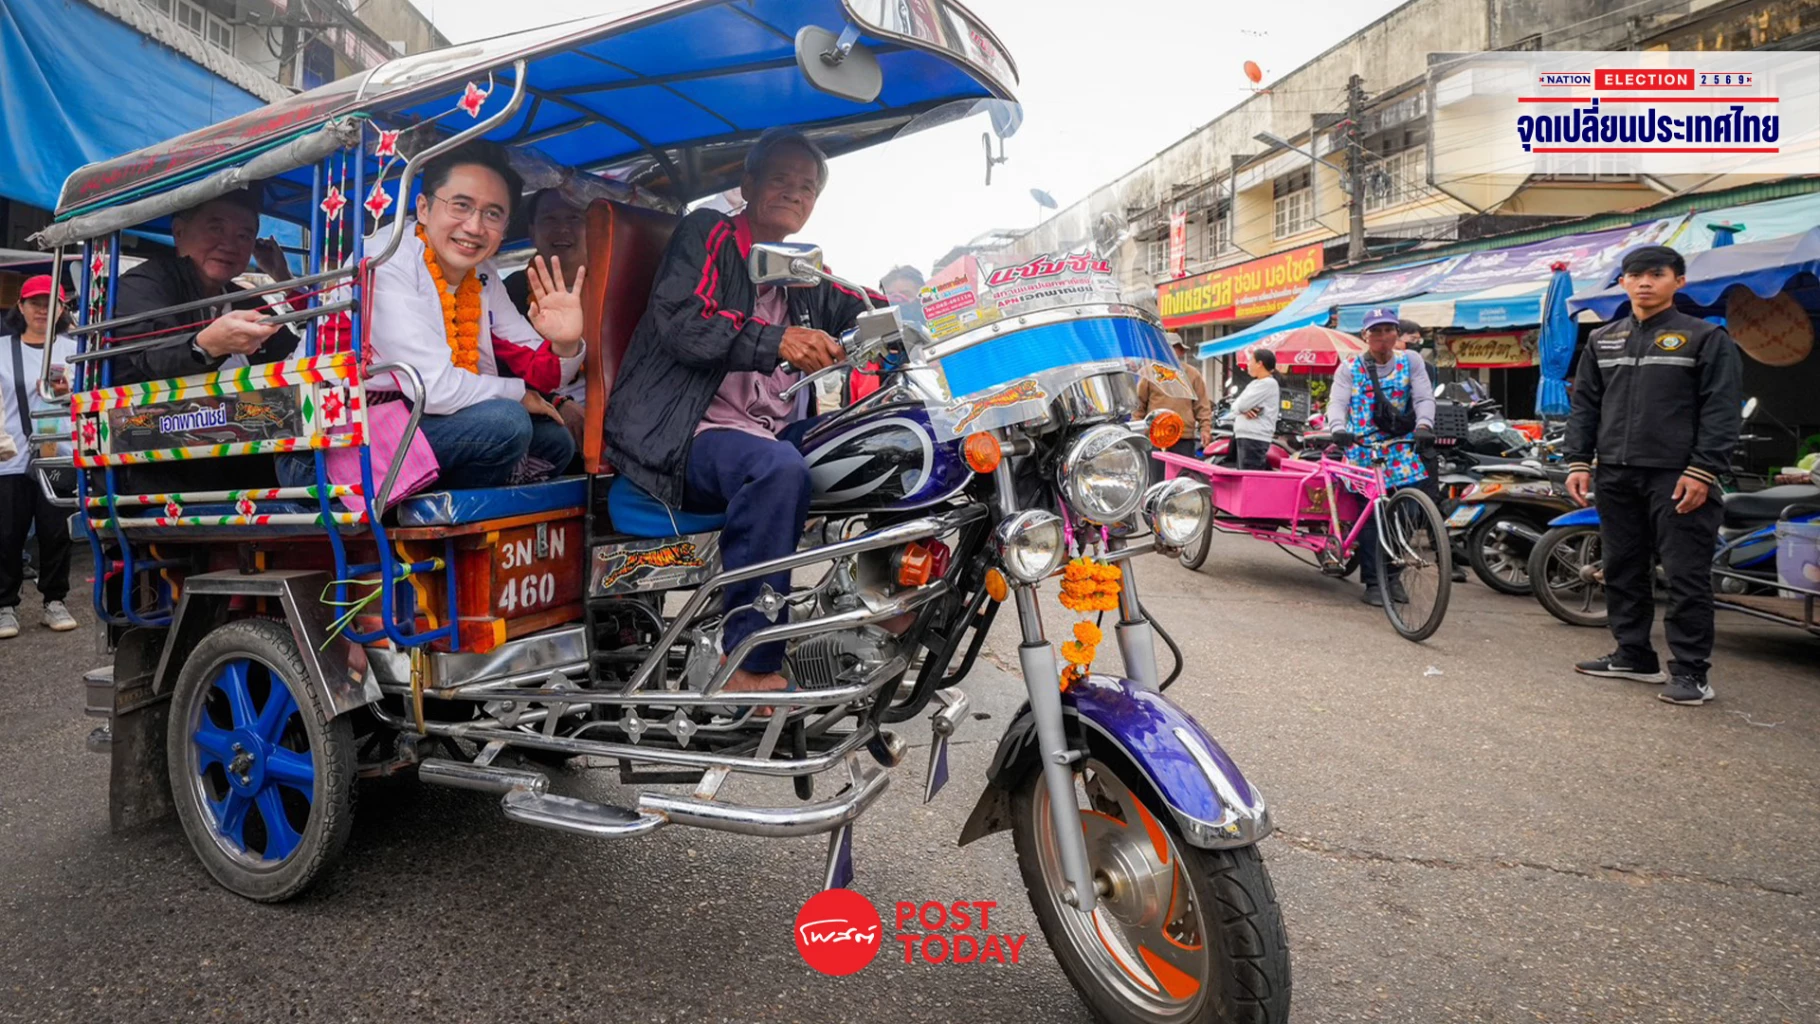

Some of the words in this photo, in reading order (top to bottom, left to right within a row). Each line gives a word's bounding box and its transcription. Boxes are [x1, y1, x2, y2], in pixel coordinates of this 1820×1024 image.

[159, 402, 227, 434] เอกพาณิชย์
[498, 572, 555, 611] 460
